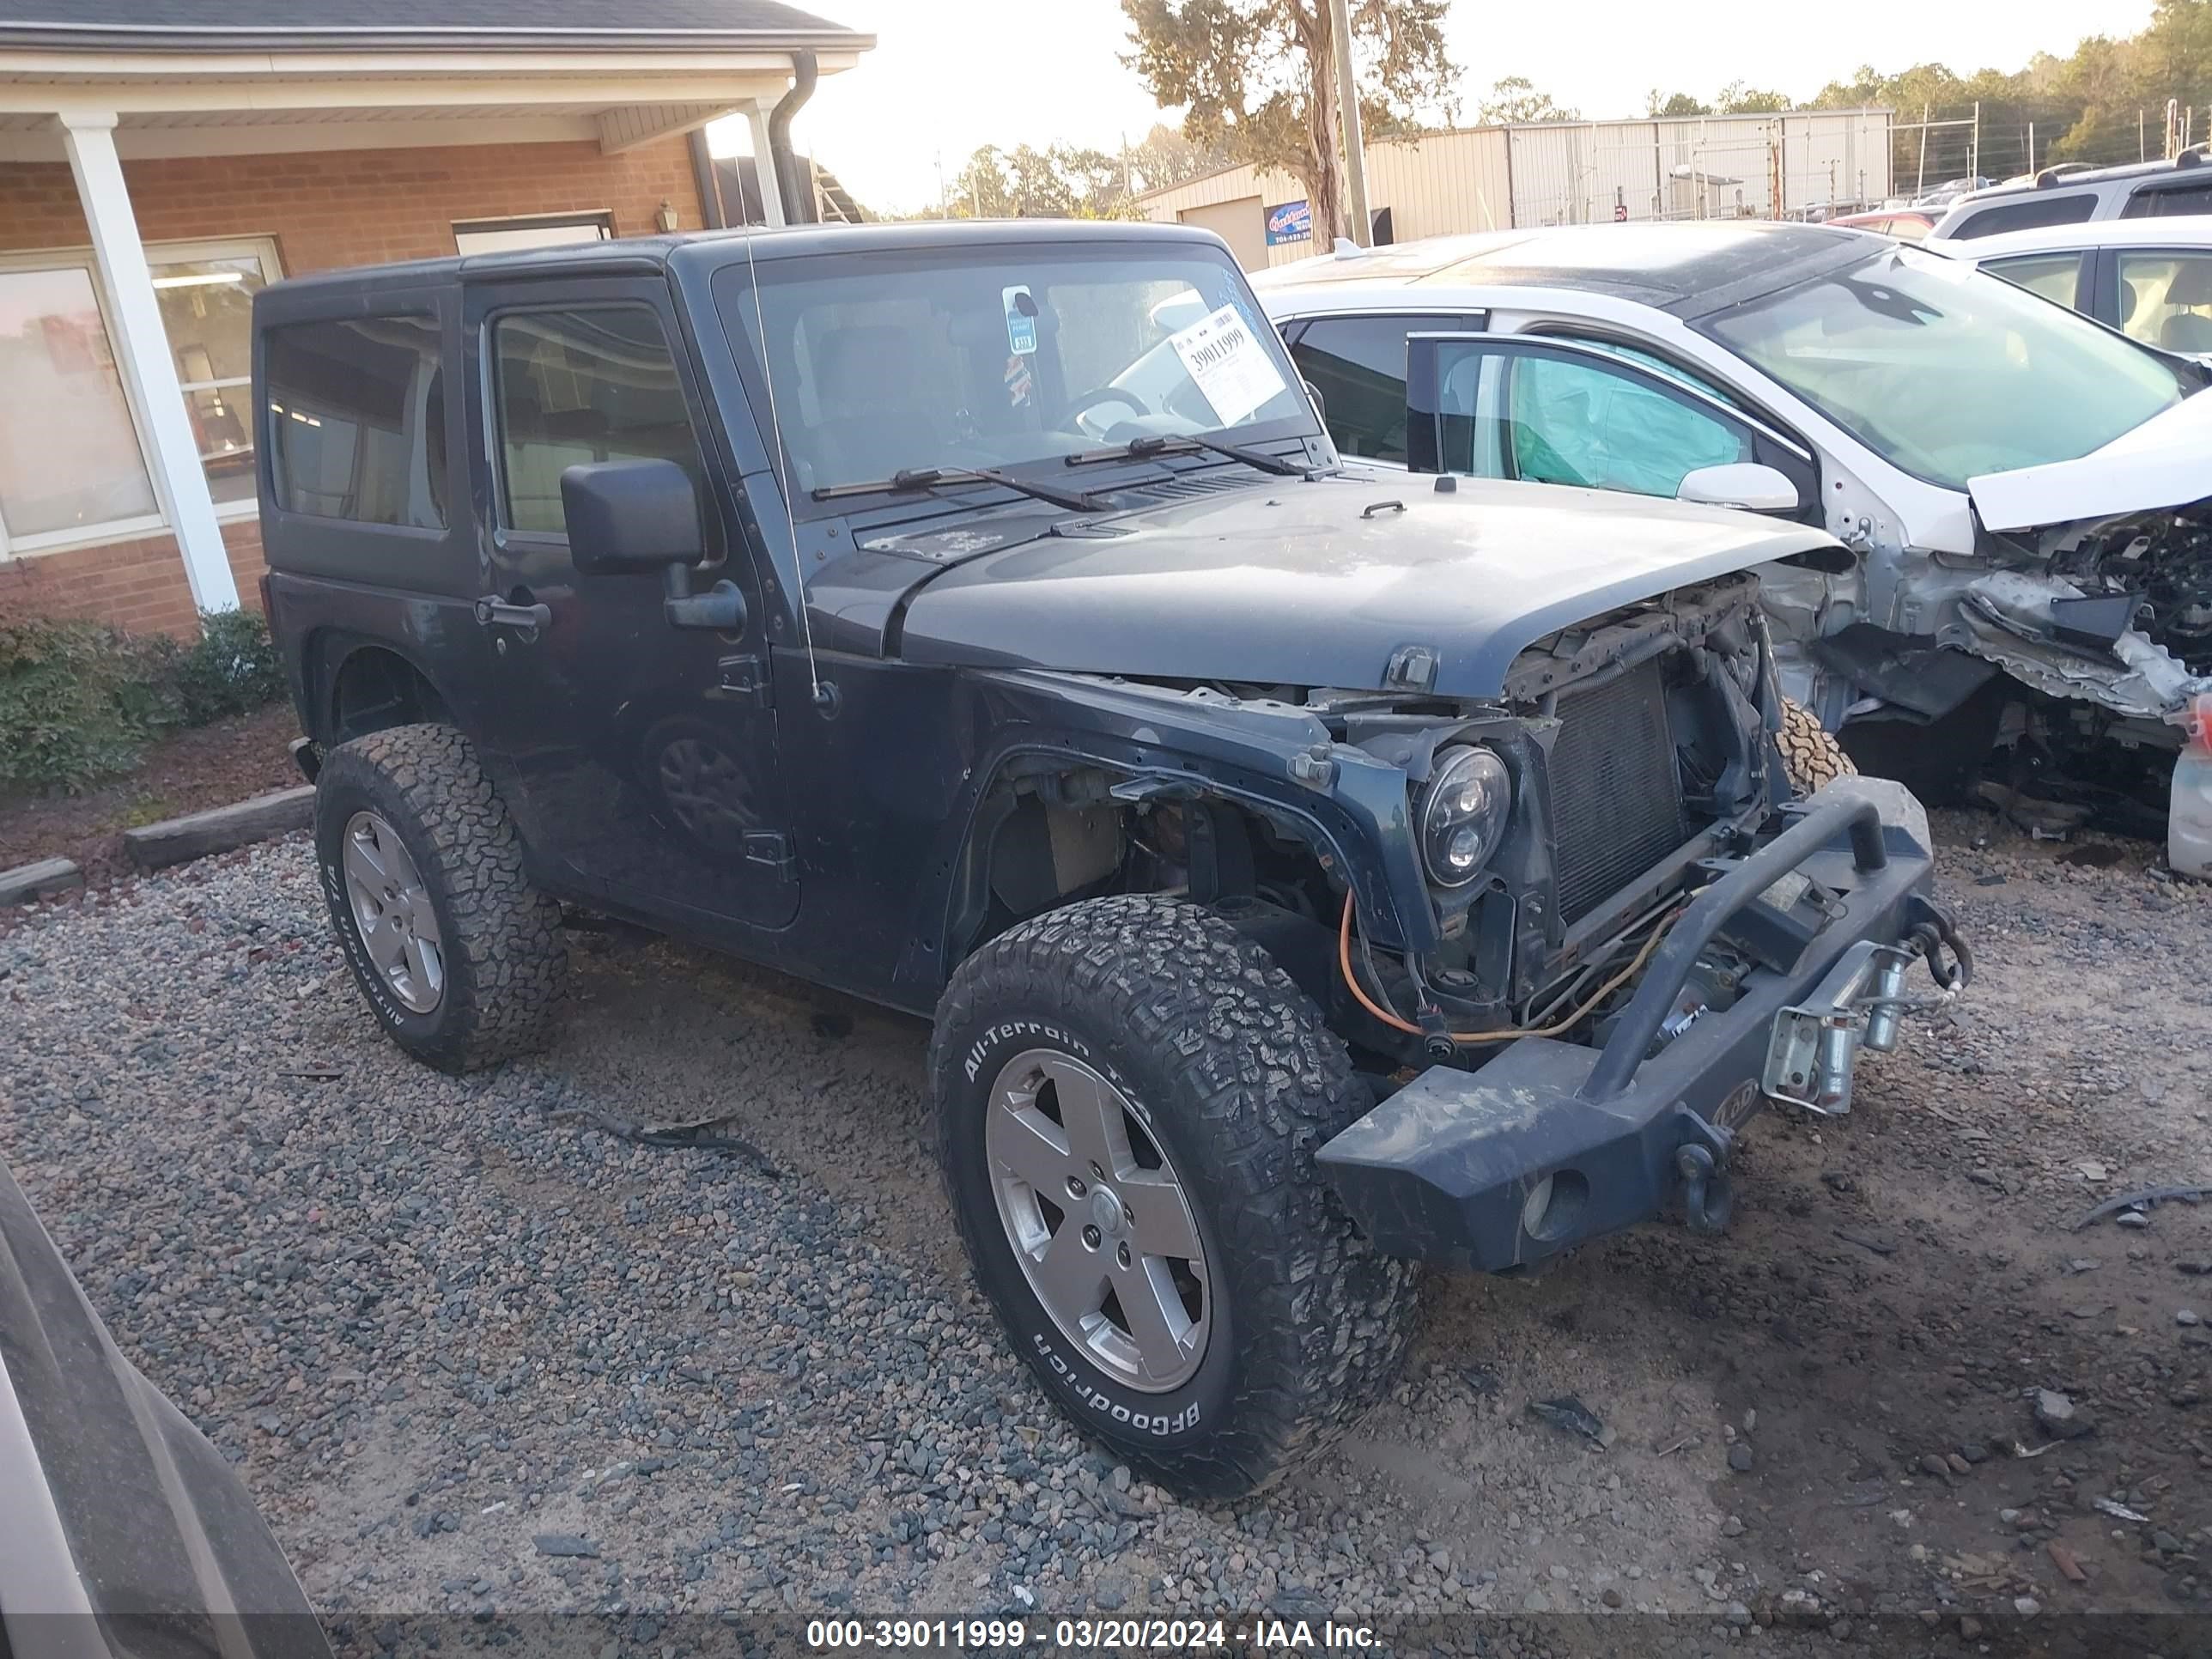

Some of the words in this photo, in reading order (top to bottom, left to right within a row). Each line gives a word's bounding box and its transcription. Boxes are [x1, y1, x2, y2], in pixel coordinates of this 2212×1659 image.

[1190, 327, 1244, 372] 39011999
[963, 1021, 1092, 1084] All-Terrain
[1033, 1334, 1200, 1437] BFGoodrich
